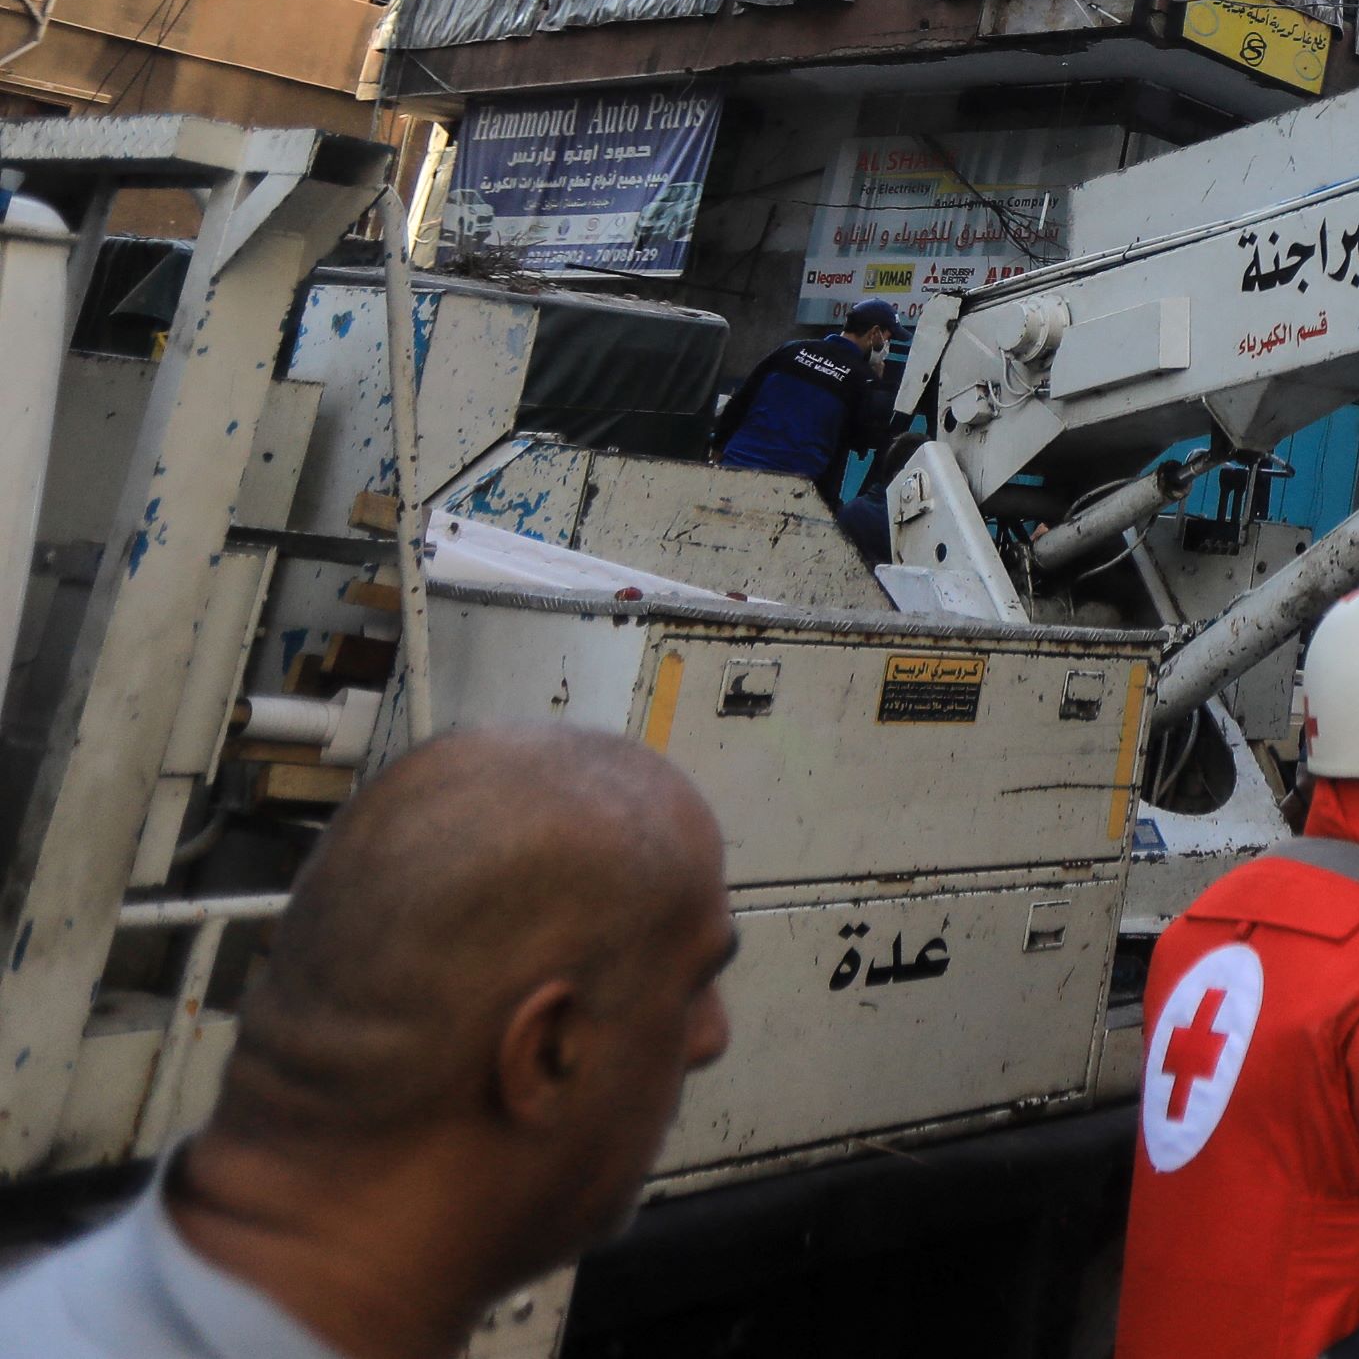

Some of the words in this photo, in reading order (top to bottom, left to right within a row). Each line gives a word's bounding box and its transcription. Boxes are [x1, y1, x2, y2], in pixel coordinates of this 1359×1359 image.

[1293, 30, 1312, 48] غيار
[1311, 36, 1327, 52] قطع
[473, 100, 578, 140] Hammoud
[588, 99, 639, 135] Auto
[644, 93, 708, 130] Parts
[507, 146, 556, 167] بارتس
[564, 144, 599, 165] اوتو
[604, 145, 651, 162] حمود
[857, 154, 881, 171] AL
[480, 176, 518, 193] الكورية
[518, 175, 567, 192] السيارات
[569, 173, 592, 191] قطع
[618, 174, 643, 189] جميع
[860, 184, 878, 195] For
[880, 183, 932, 196] Electricity
[893, 221, 953, 250] للكهرباء
[816, 270, 855, 286] legrand
[879, 270, 913, 287] VIMAR
[940, 276, 969, 285] ELECTRIC
[941, 268, 976, 278] MITSUBISHI
[1297, 310, 1328, 348] قسم
[1238, 323, 1292, 359] الكهرباء
[893, 661, 928, 680] الربيع
[829, 921, 951, 991] عدة
